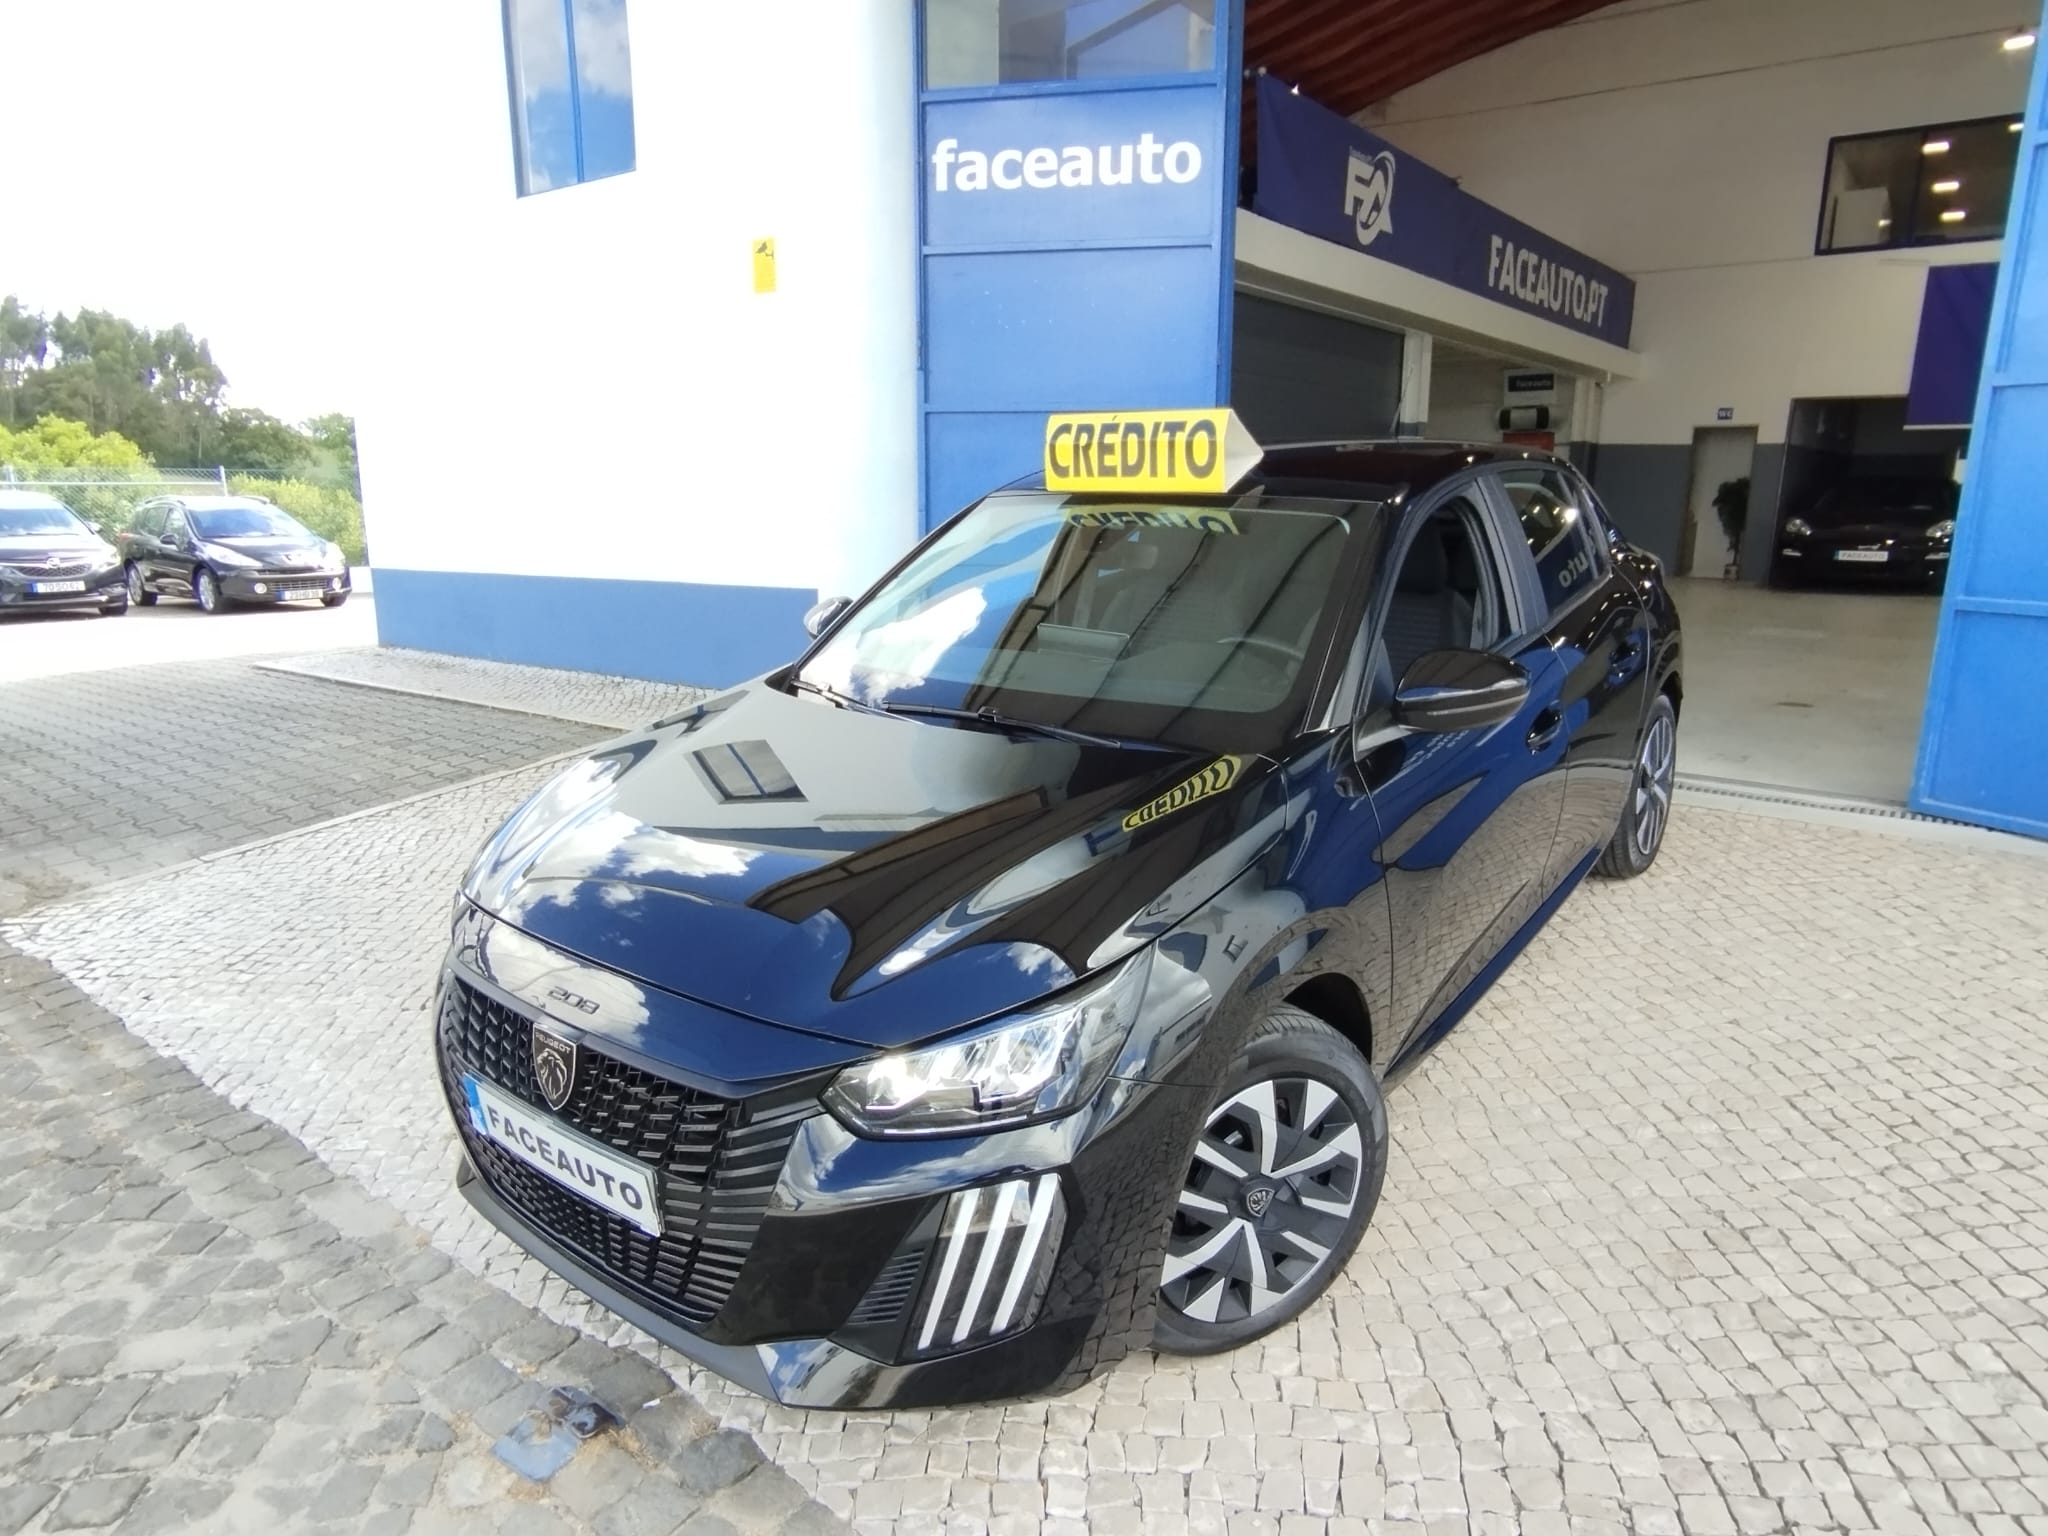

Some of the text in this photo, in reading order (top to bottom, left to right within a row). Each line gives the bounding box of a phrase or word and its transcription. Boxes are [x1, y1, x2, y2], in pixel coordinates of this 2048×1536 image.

[931, 132, 1202, 192] faceauto
[1488, 233, 1609, 328] FACEAUTO.PT
[1049, 415, 1218, 480] CRÉDITO
[1841, 551, 1885, 560] FACEAUTO
[547, 986, 601, 1015] 208
[535, 1032, 572, 1054] PEUGEOT
[486, 1105, 643, 1210] FACEAUTO
